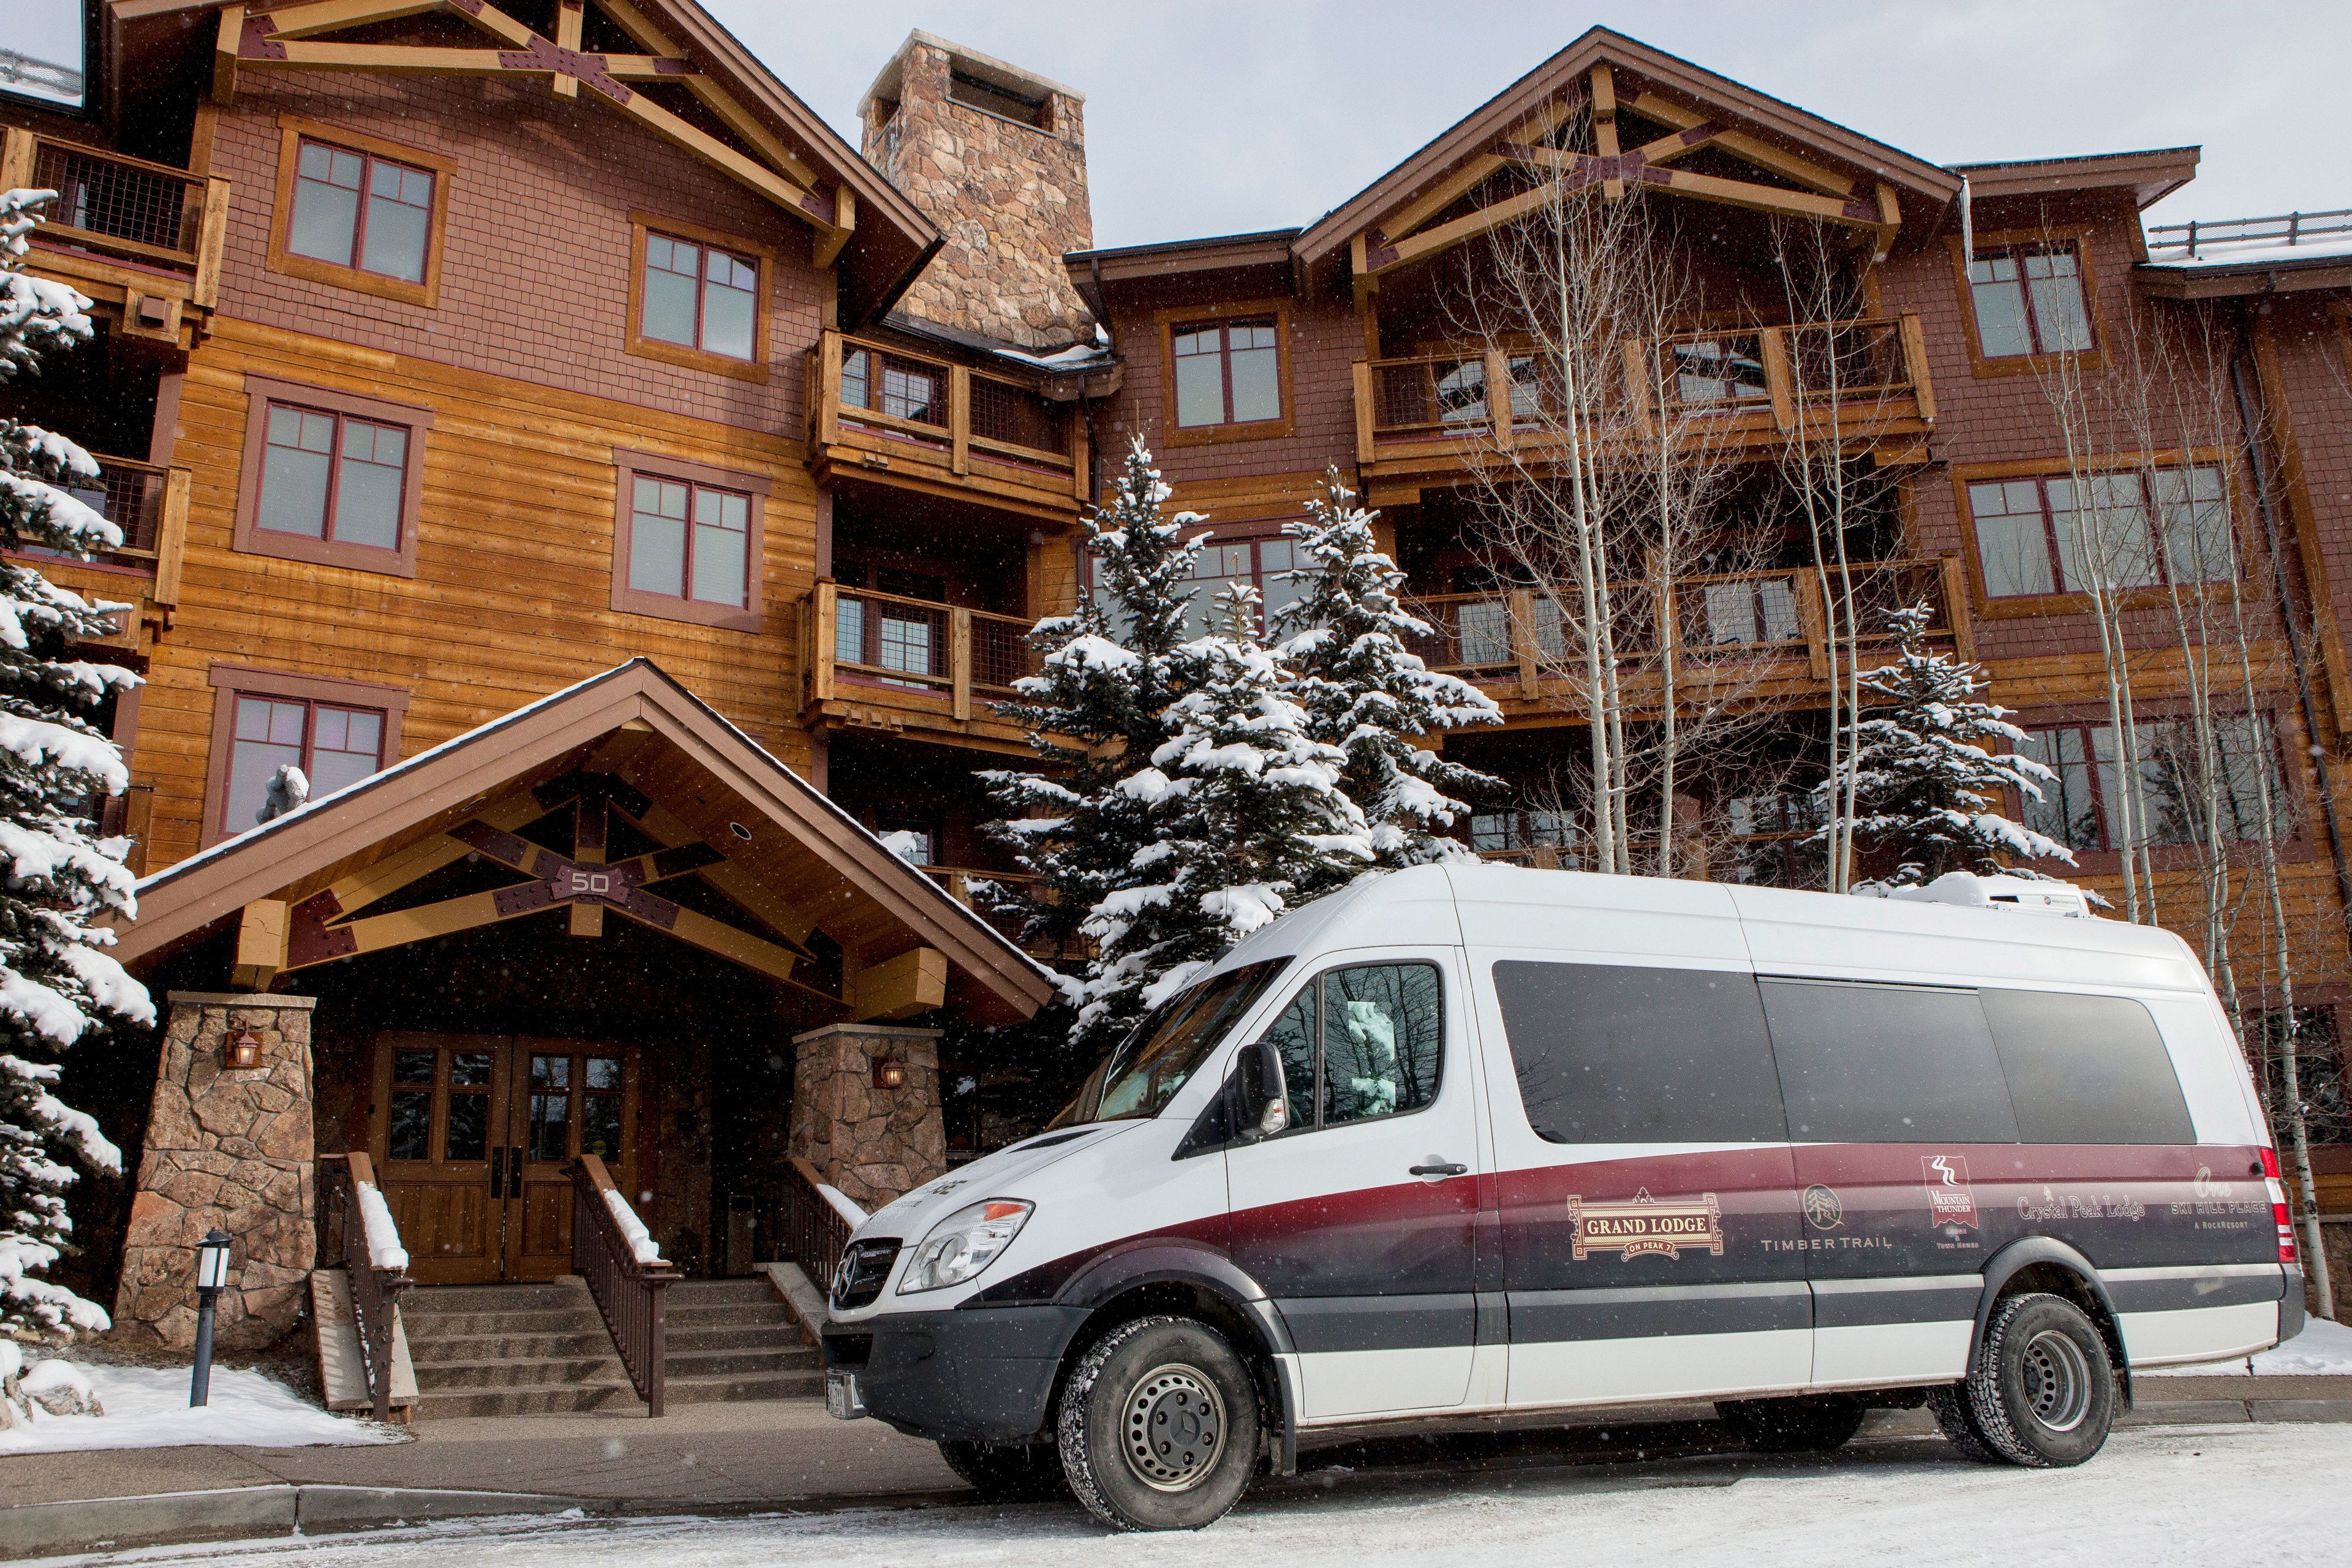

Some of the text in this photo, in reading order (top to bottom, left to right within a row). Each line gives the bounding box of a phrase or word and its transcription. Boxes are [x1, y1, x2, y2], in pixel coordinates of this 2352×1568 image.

[571, 872, 609, 892] 50
[2194, 1166, 2232, 1197] One
[1931, 1190, 1970, 1205] MOUNTAIN
[2018, 1194, 2145, 1223] Crystal Peak Lodge
[2171, 1201, 2266, 1215] SKI HILL PLACE
[1587, 1217, 1706, 1235] GRAND LODGE
[1629, 1243, 1640, 1253] ON
[1643, 1242, 1664, 1250] PEAK
[1760, 1237, 1892, 1251] TIMBER TRAIL
